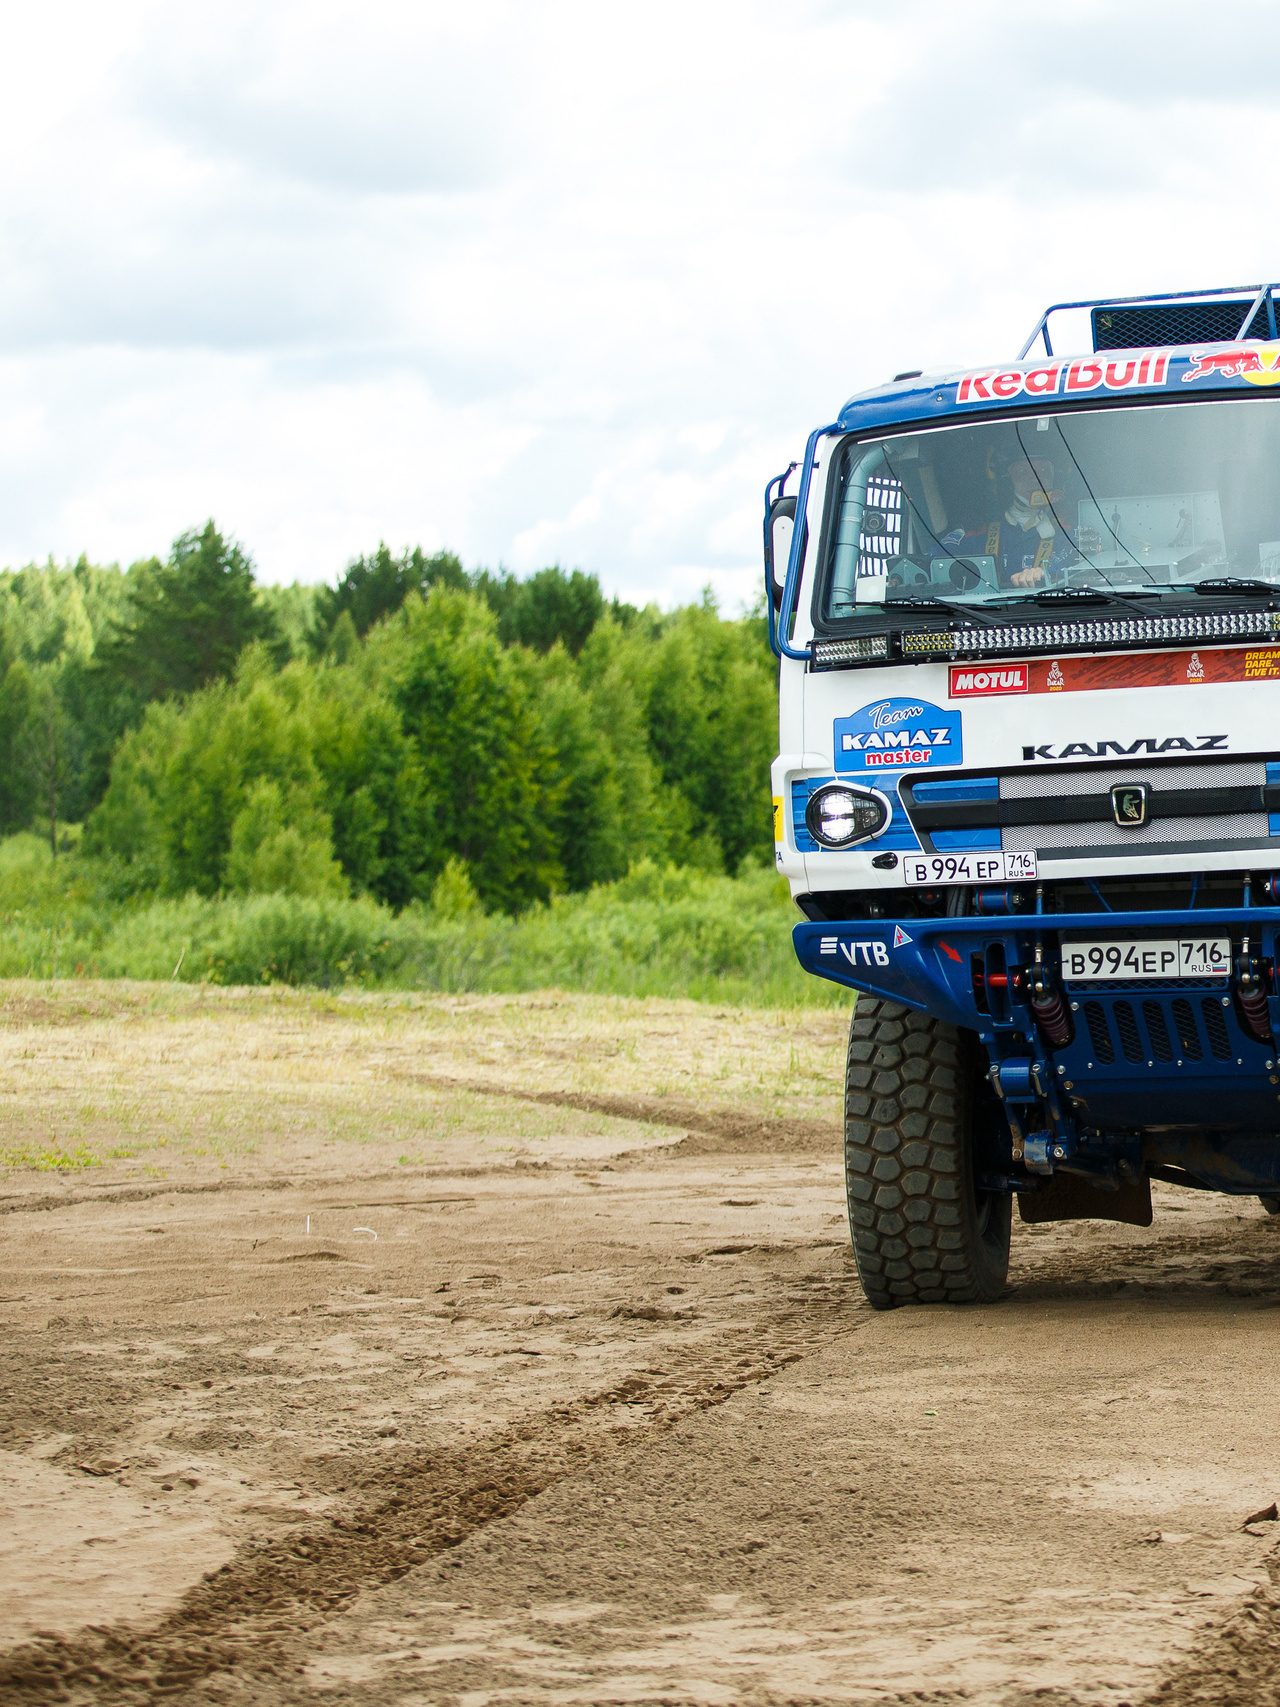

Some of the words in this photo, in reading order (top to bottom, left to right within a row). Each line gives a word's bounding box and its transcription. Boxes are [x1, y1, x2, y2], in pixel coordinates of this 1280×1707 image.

[957, 360, 1064, 402] Red
[1066, 350, 1172, 391] Bull
[1245, 660, 1274, 668] DARE.
[1245, 668, 1267, 677] LIVE
[1268, 667, 1280, 675] IT.
[955, 671, 1024, 690] MOTUL
[869, 702, 923, 729] Team
[842, 728, 952, 751] KAMAZ
[1022, 735, 1229, 761] KAMAZ
[866, 749, 931, 765] master
[1008, 854, 1031, 868] 716
[839, 941, 890, 966] VTB
[1181, 942, 1222, 964] 716
[1191, 964, 1212, 972] RUS
